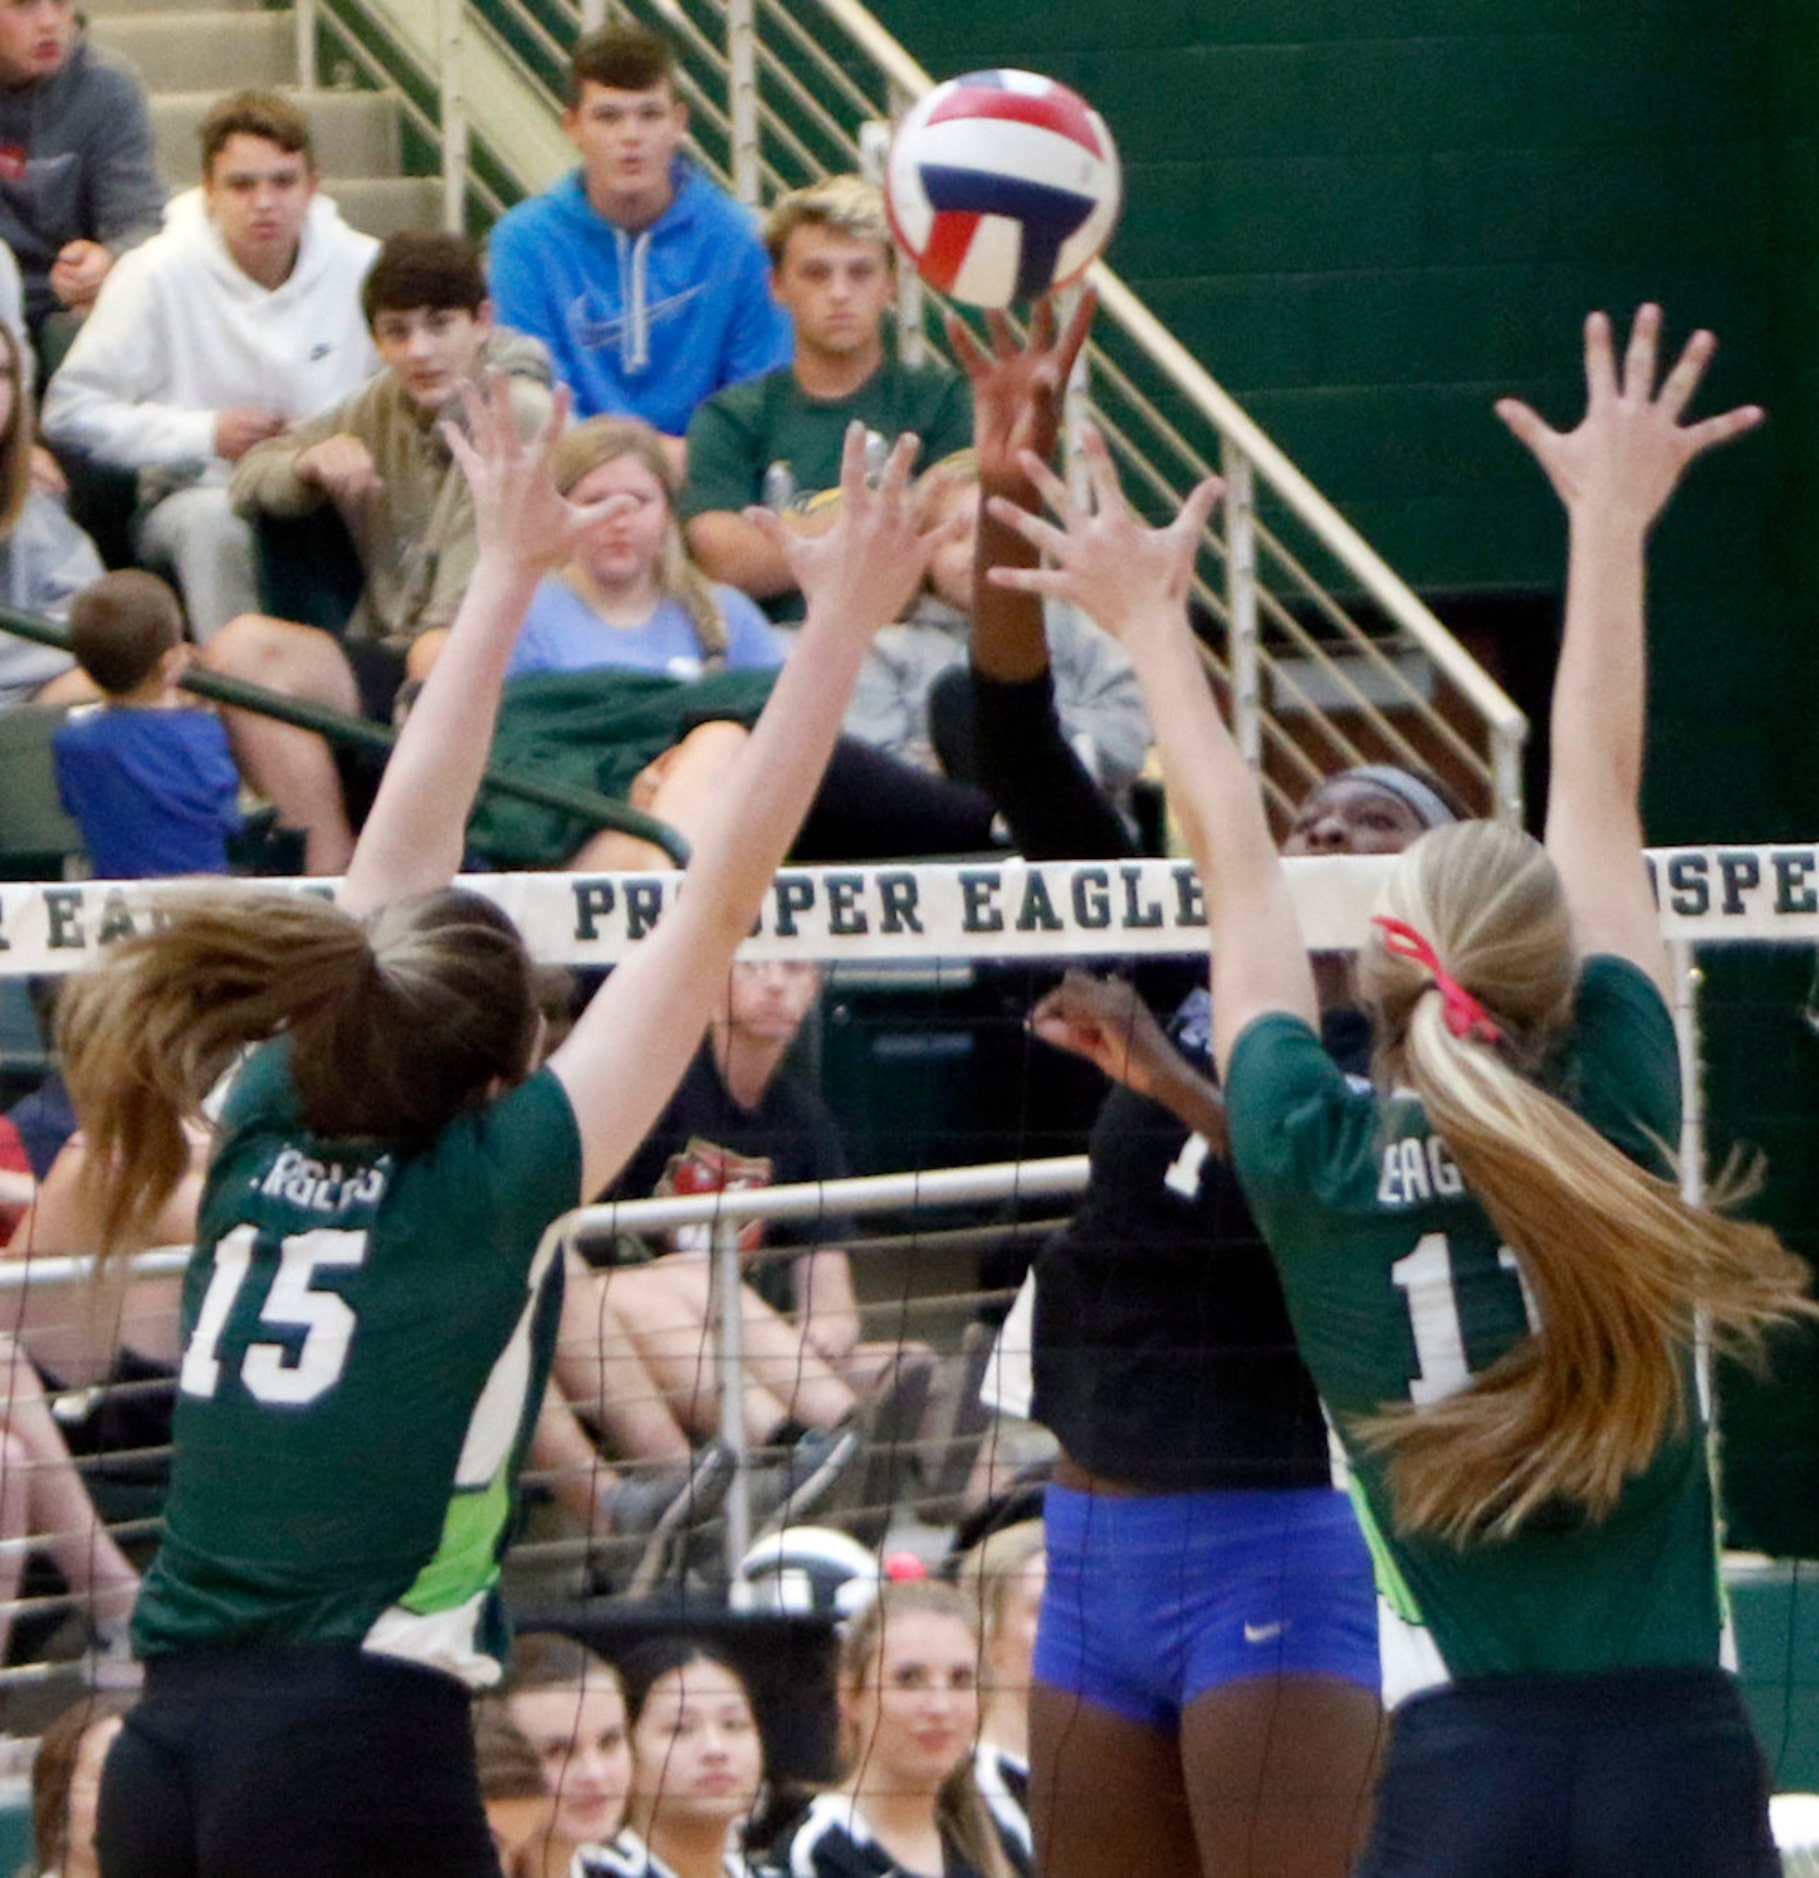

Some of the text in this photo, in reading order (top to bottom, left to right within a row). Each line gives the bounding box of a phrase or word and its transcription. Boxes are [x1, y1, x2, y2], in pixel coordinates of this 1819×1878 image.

[572, 865, 1208, 941] PRPER EAGLE
[1377, 1135, 1463, 1206] EAG
[180, 1222, 368, 1404] 15
[1391, 1231, 1543, 1408] 1
